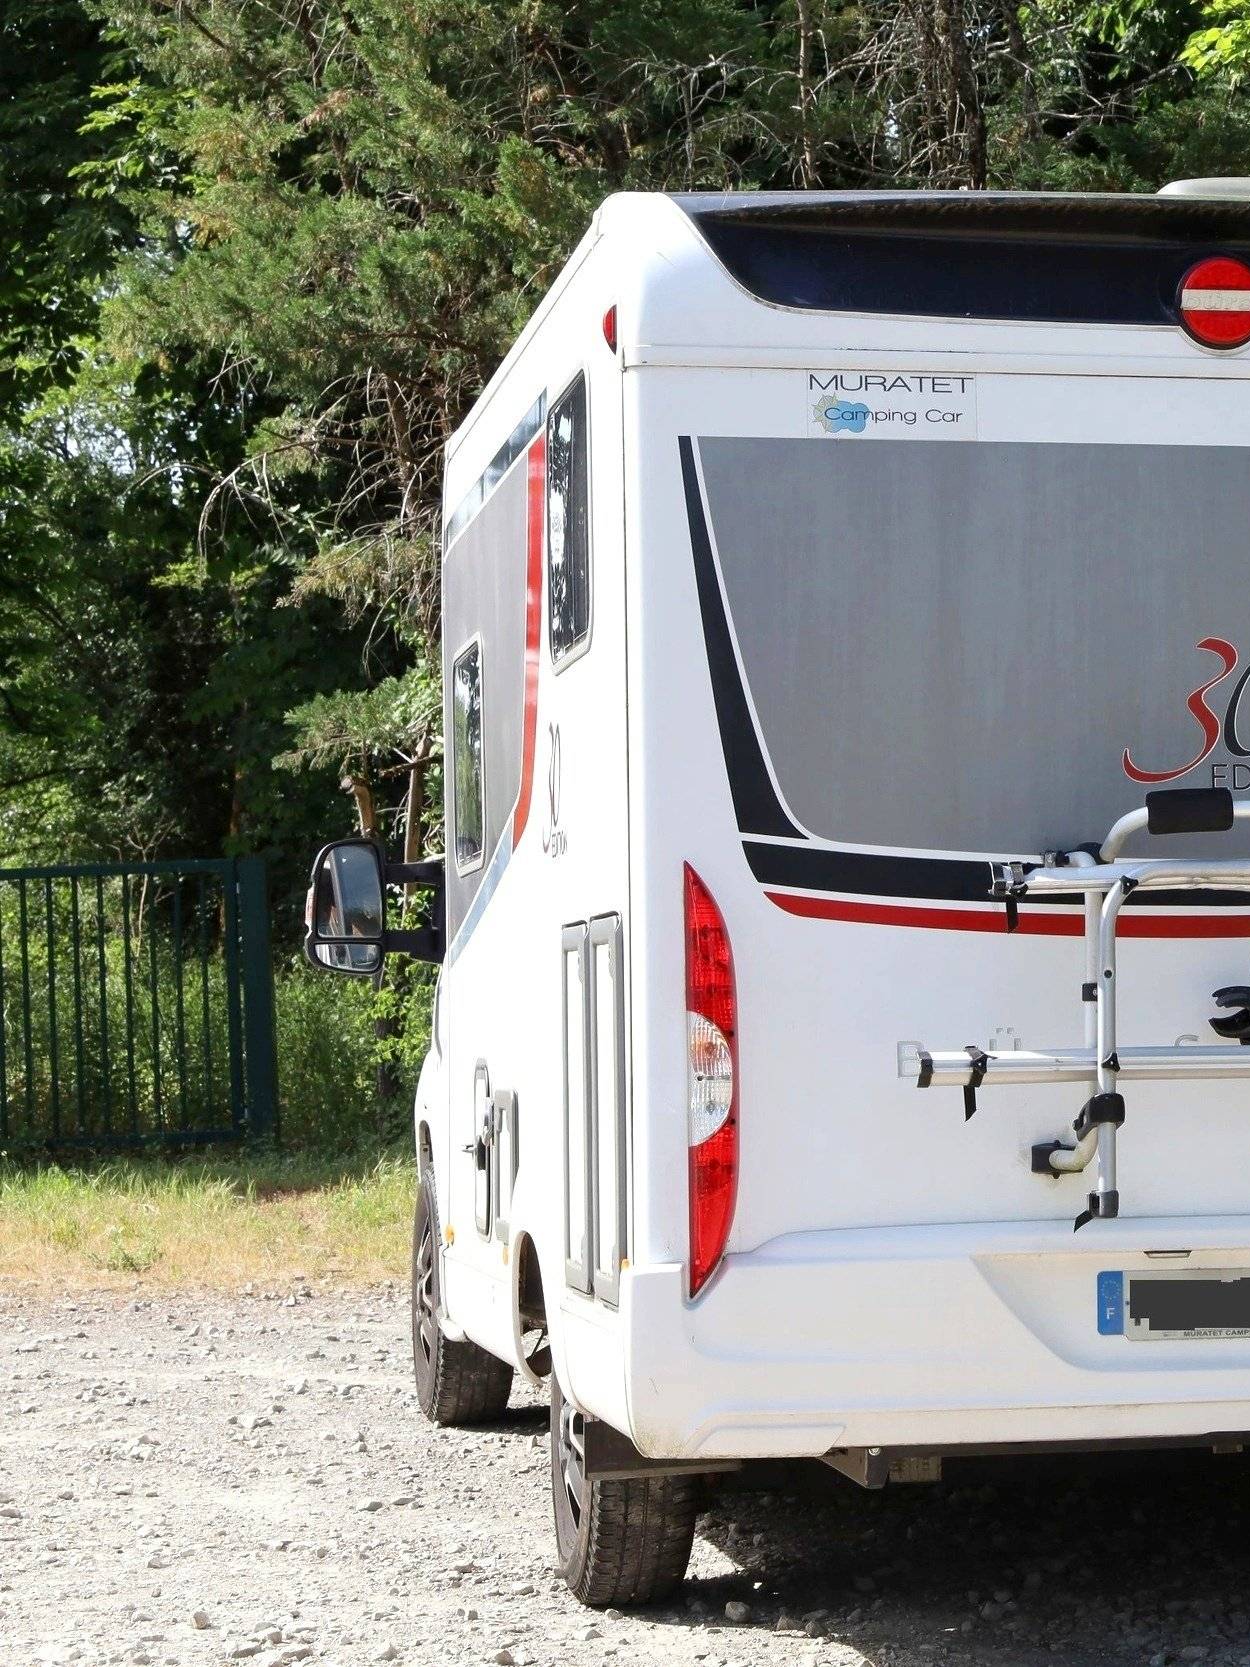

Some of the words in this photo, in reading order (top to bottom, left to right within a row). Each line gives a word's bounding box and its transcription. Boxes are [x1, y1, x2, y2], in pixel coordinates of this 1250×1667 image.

[808, 373, 975, 394] MURATET
[823, 406, 917, 426] Camping
[924, 408, 964, 423] Car
[1105, 1307, 1116, 1320] F
